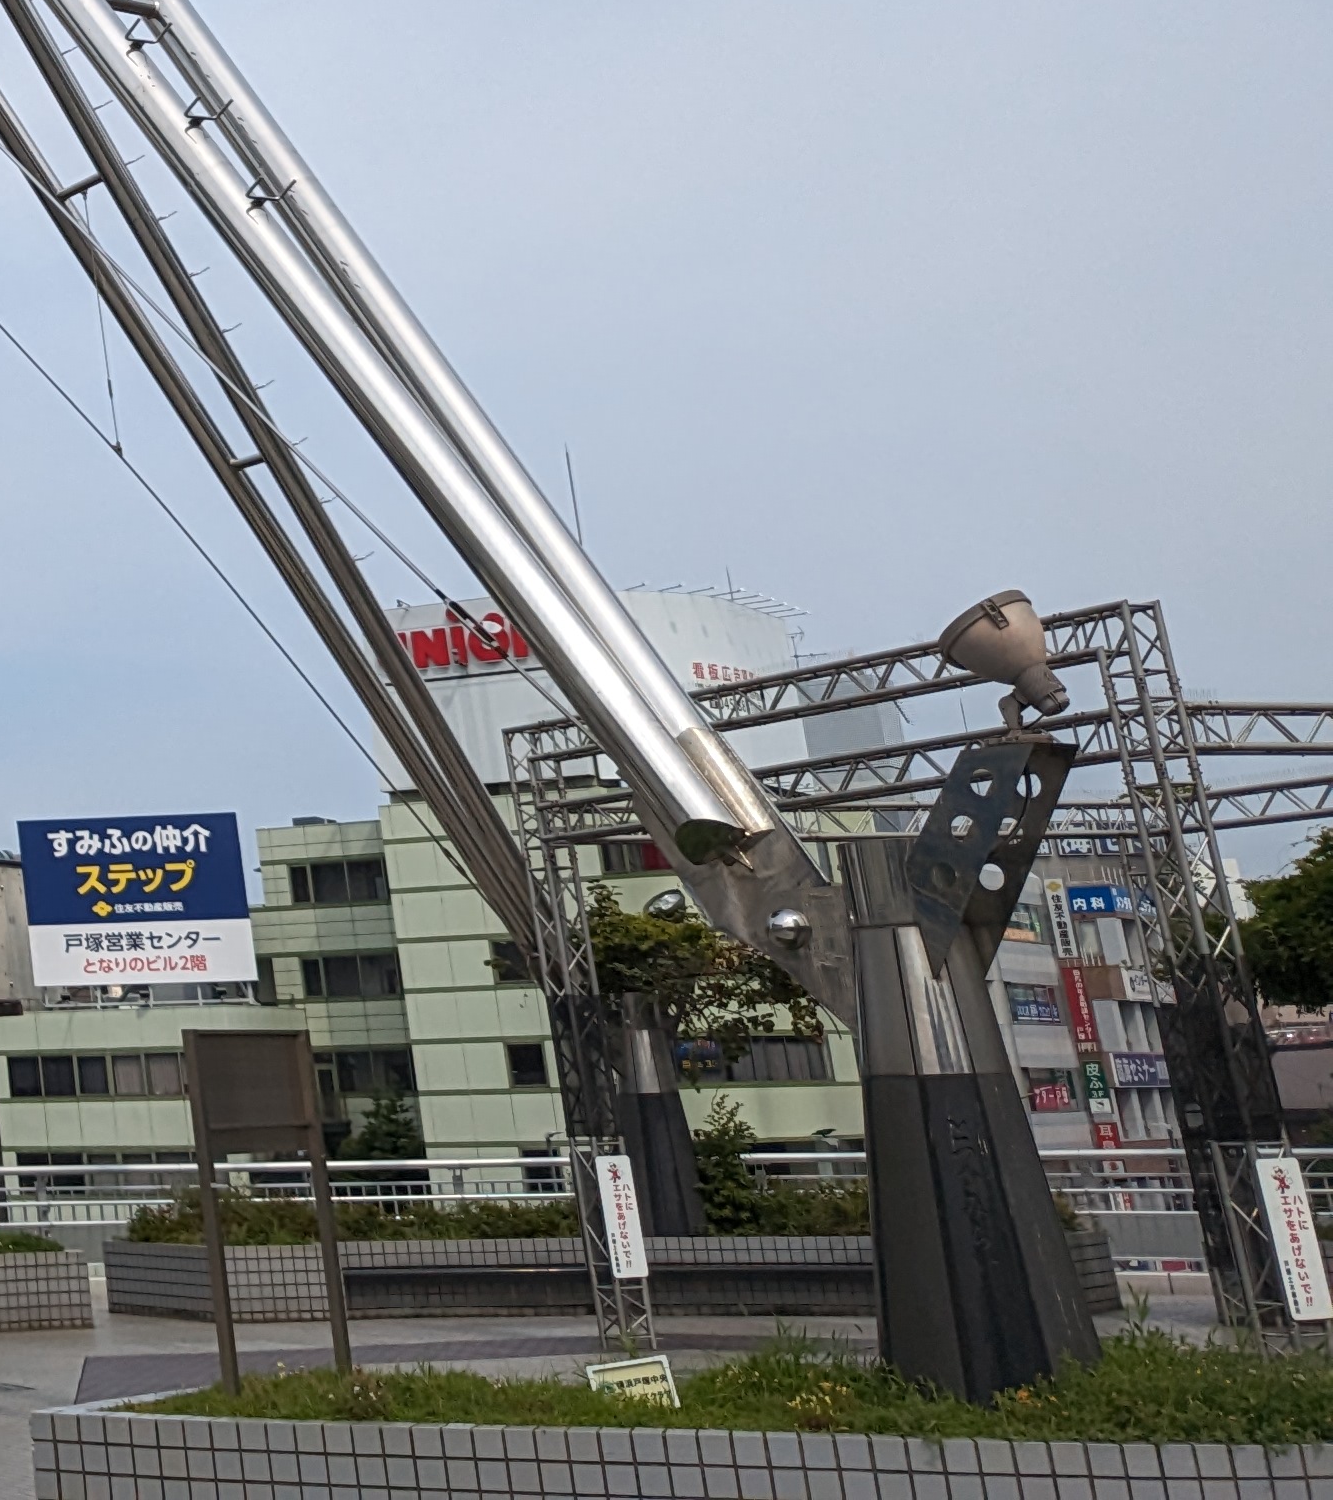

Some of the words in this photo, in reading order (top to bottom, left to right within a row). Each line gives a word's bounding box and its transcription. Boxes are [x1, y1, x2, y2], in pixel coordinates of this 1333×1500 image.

[47, 823, 211, 857] すみふの仲介
[76, 859, 196, 895] ステップ
[114, 901, 184, 914] 住友不動産販売
[1072, 896, 1106, 911] 内科
[1051, 894, 1074, 957] 住友不動産販売
[63, 930, 221, 953] 戸塚営業センター
[83, 954, 208, 974] となりのビル2階
[622, 1183, 634, 1211] ハトに
[1293, 1194, 1310, 1231] ハトに
